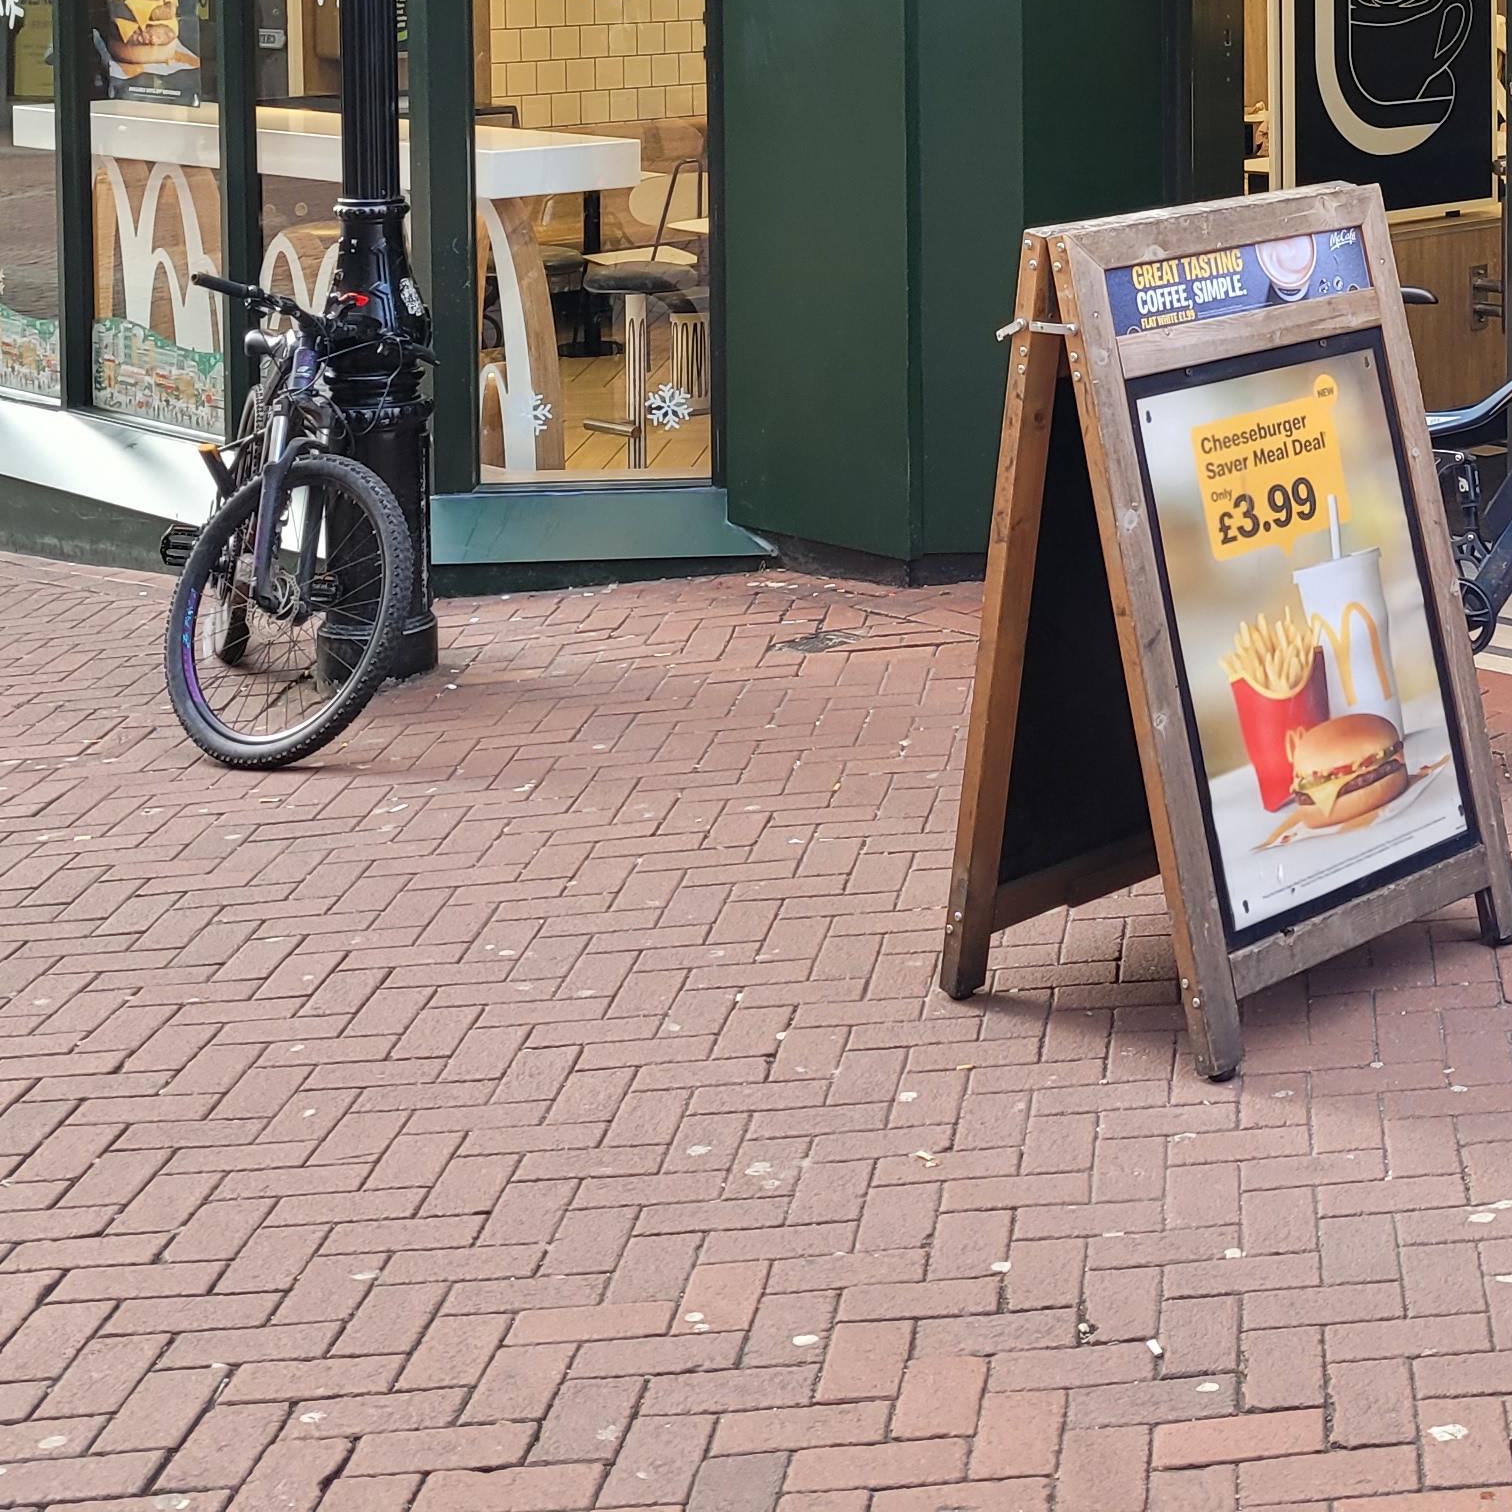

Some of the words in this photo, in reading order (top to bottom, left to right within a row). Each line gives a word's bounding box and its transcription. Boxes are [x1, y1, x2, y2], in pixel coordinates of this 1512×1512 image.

[1132, 259, 1180, 290] GREAT
[1181, 249, 1243, 280] TASTING
[1137, 284, 1193, 314] COFFEE,
[1193, 274, 1247, 304] SIMPLE.
[1141, 317, 1157, 329] FLAT
[1157, 312, 1180, 325] WHITE
[1179, 309, 1196, 321] £1.99
[1317, 387, 1334, 398] NEW
[1201, 415, 1307, 454] Cheeseburger
[1205, 456, 1248, 479] Saver
[1253, 442, 1289, 467] Meal
[1211, 488, 1233, 502] Only
[1219, 477, 1317, 545] £3.99
